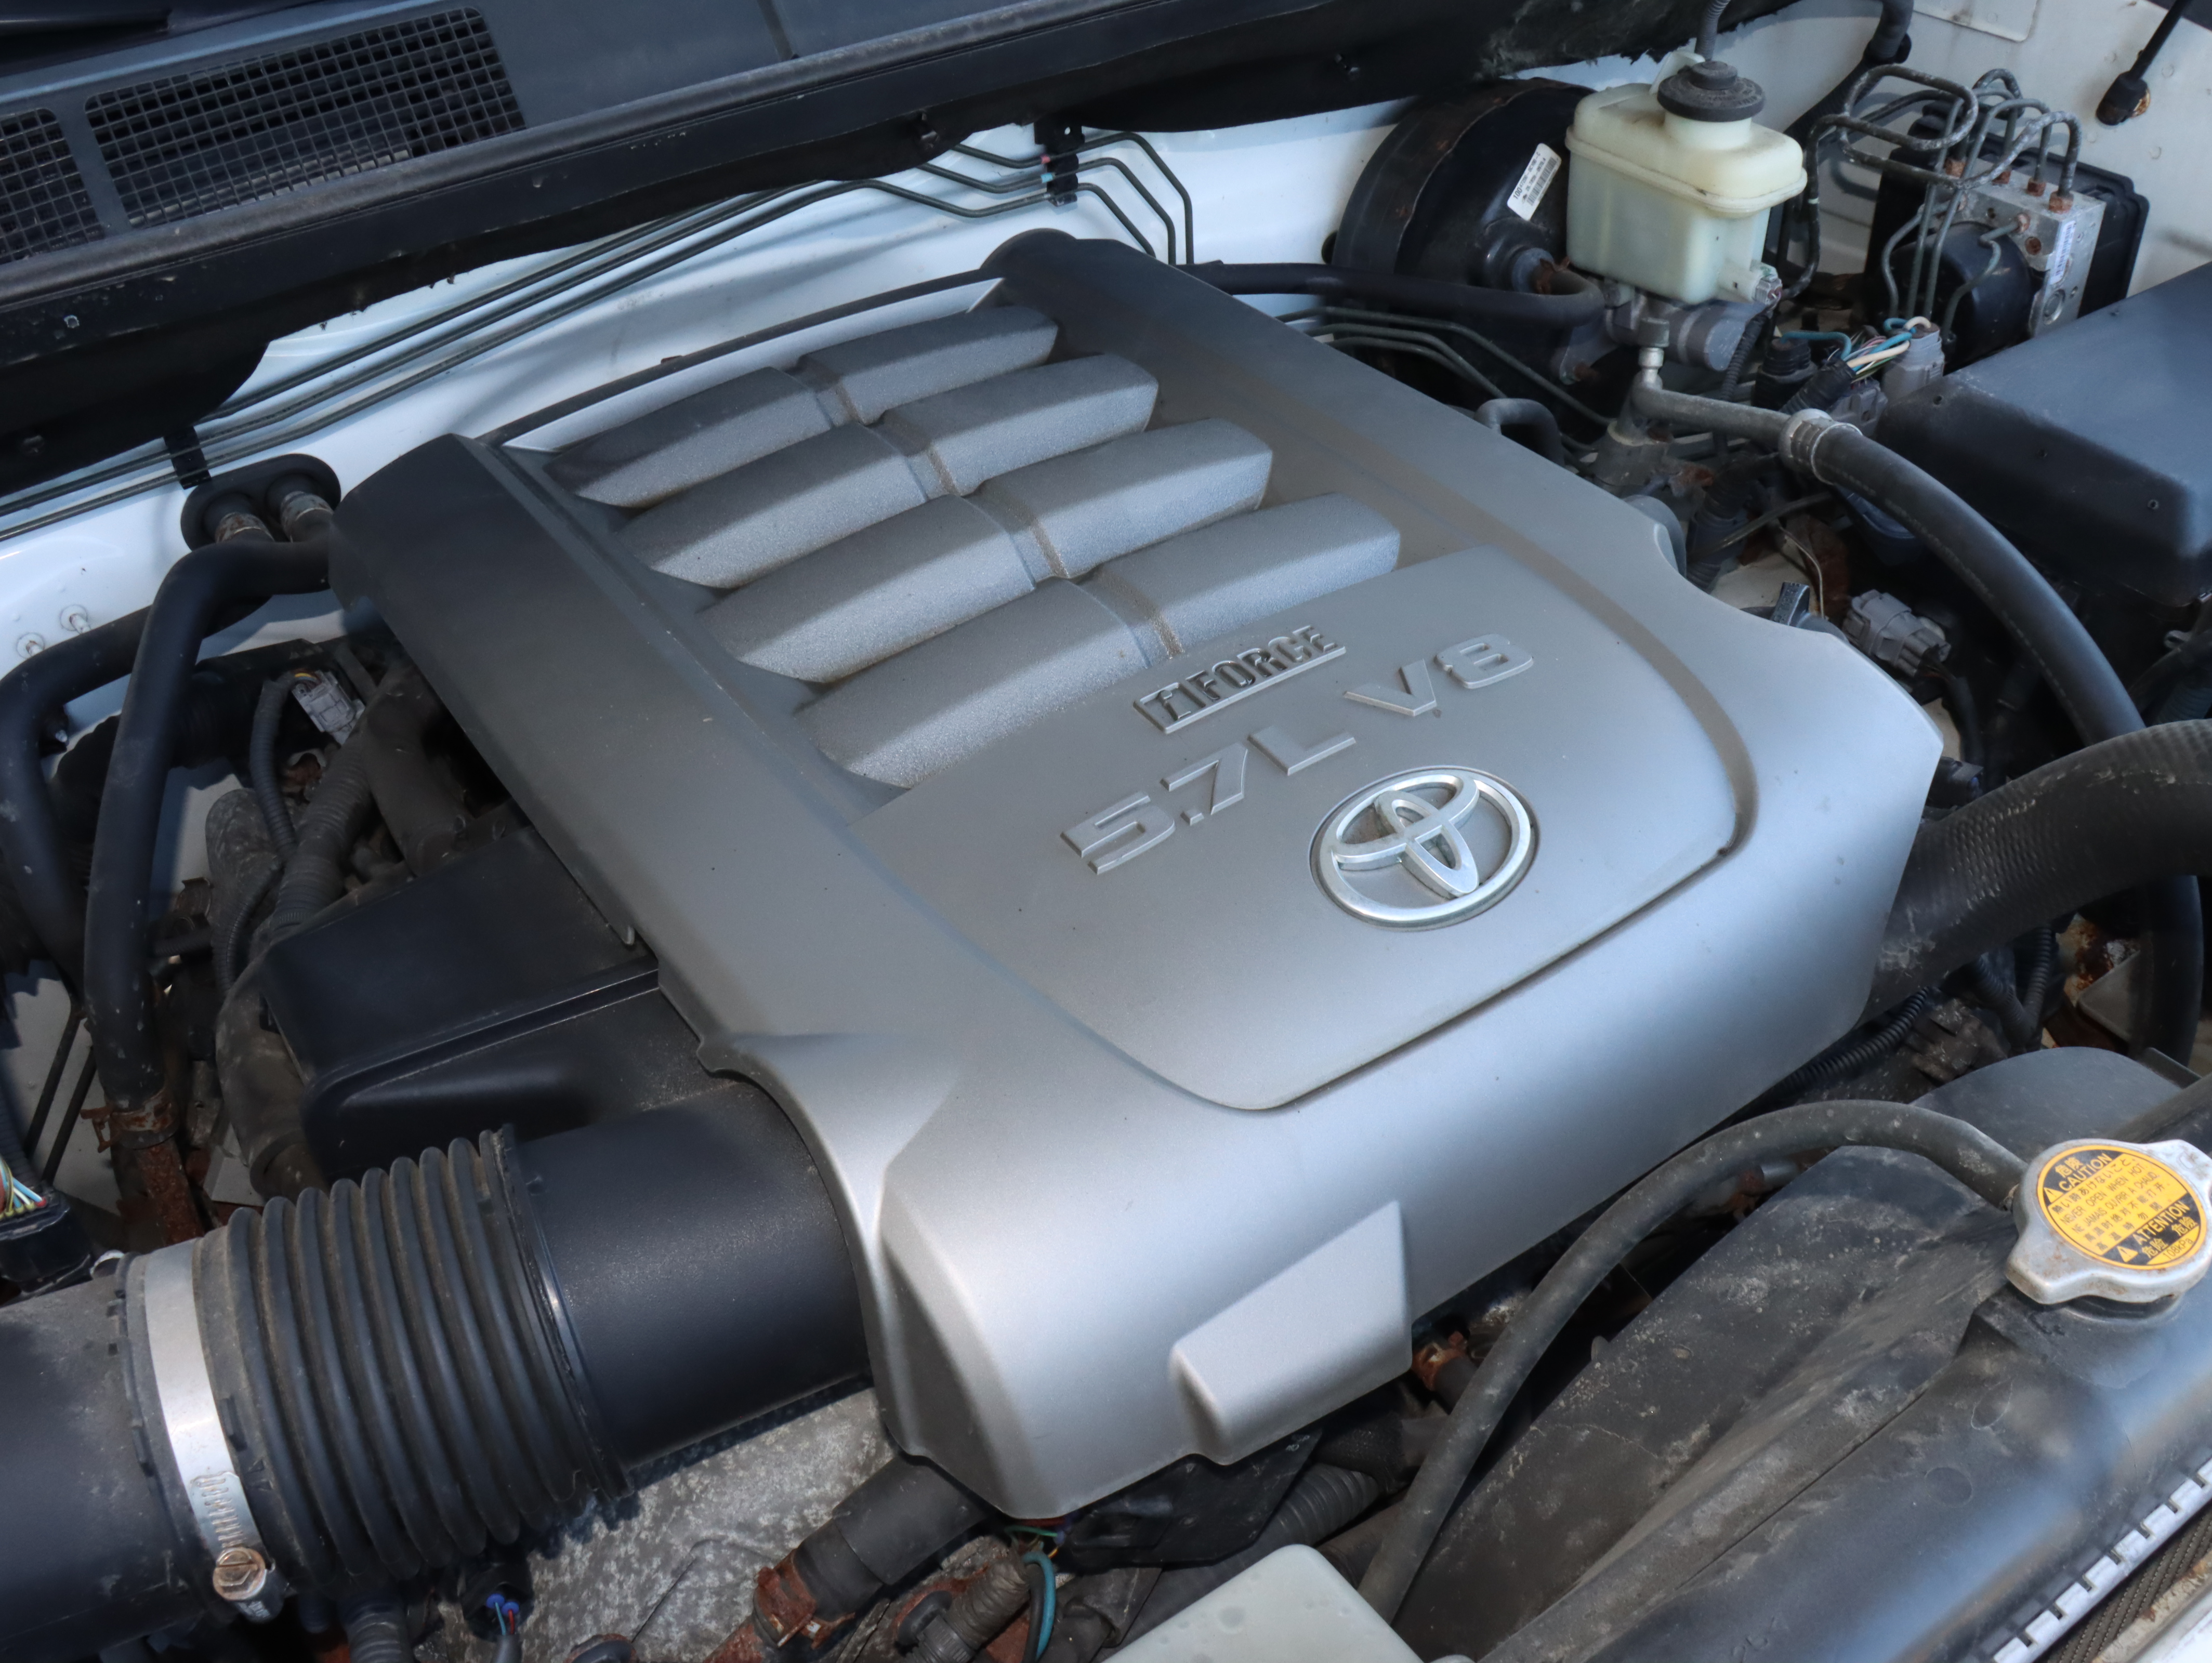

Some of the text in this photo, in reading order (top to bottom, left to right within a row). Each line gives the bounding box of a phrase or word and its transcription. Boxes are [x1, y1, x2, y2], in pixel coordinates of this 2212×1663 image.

[1513, 187, 1522, 200] 100
[1344, 633, 1534, 717] V8
[2059, 1153, 2113, 1191] CAUTION
[2060, 1206, 2084, 1225] NEVER
[2086, 1190, 2107, 1207] OPEN
[2106, 1176, 2129, 1192] WHEN
[2072, 1224, 2084, 1234] NE
[2083, 1208, 2108, 1227] JAMAIS
[2105, 1191, 2130, 1209] OUVRIR
[2132, 1201, 2190, 1245] ATTENTION
[2163, 1238, 2194, 1260] 108kPa
